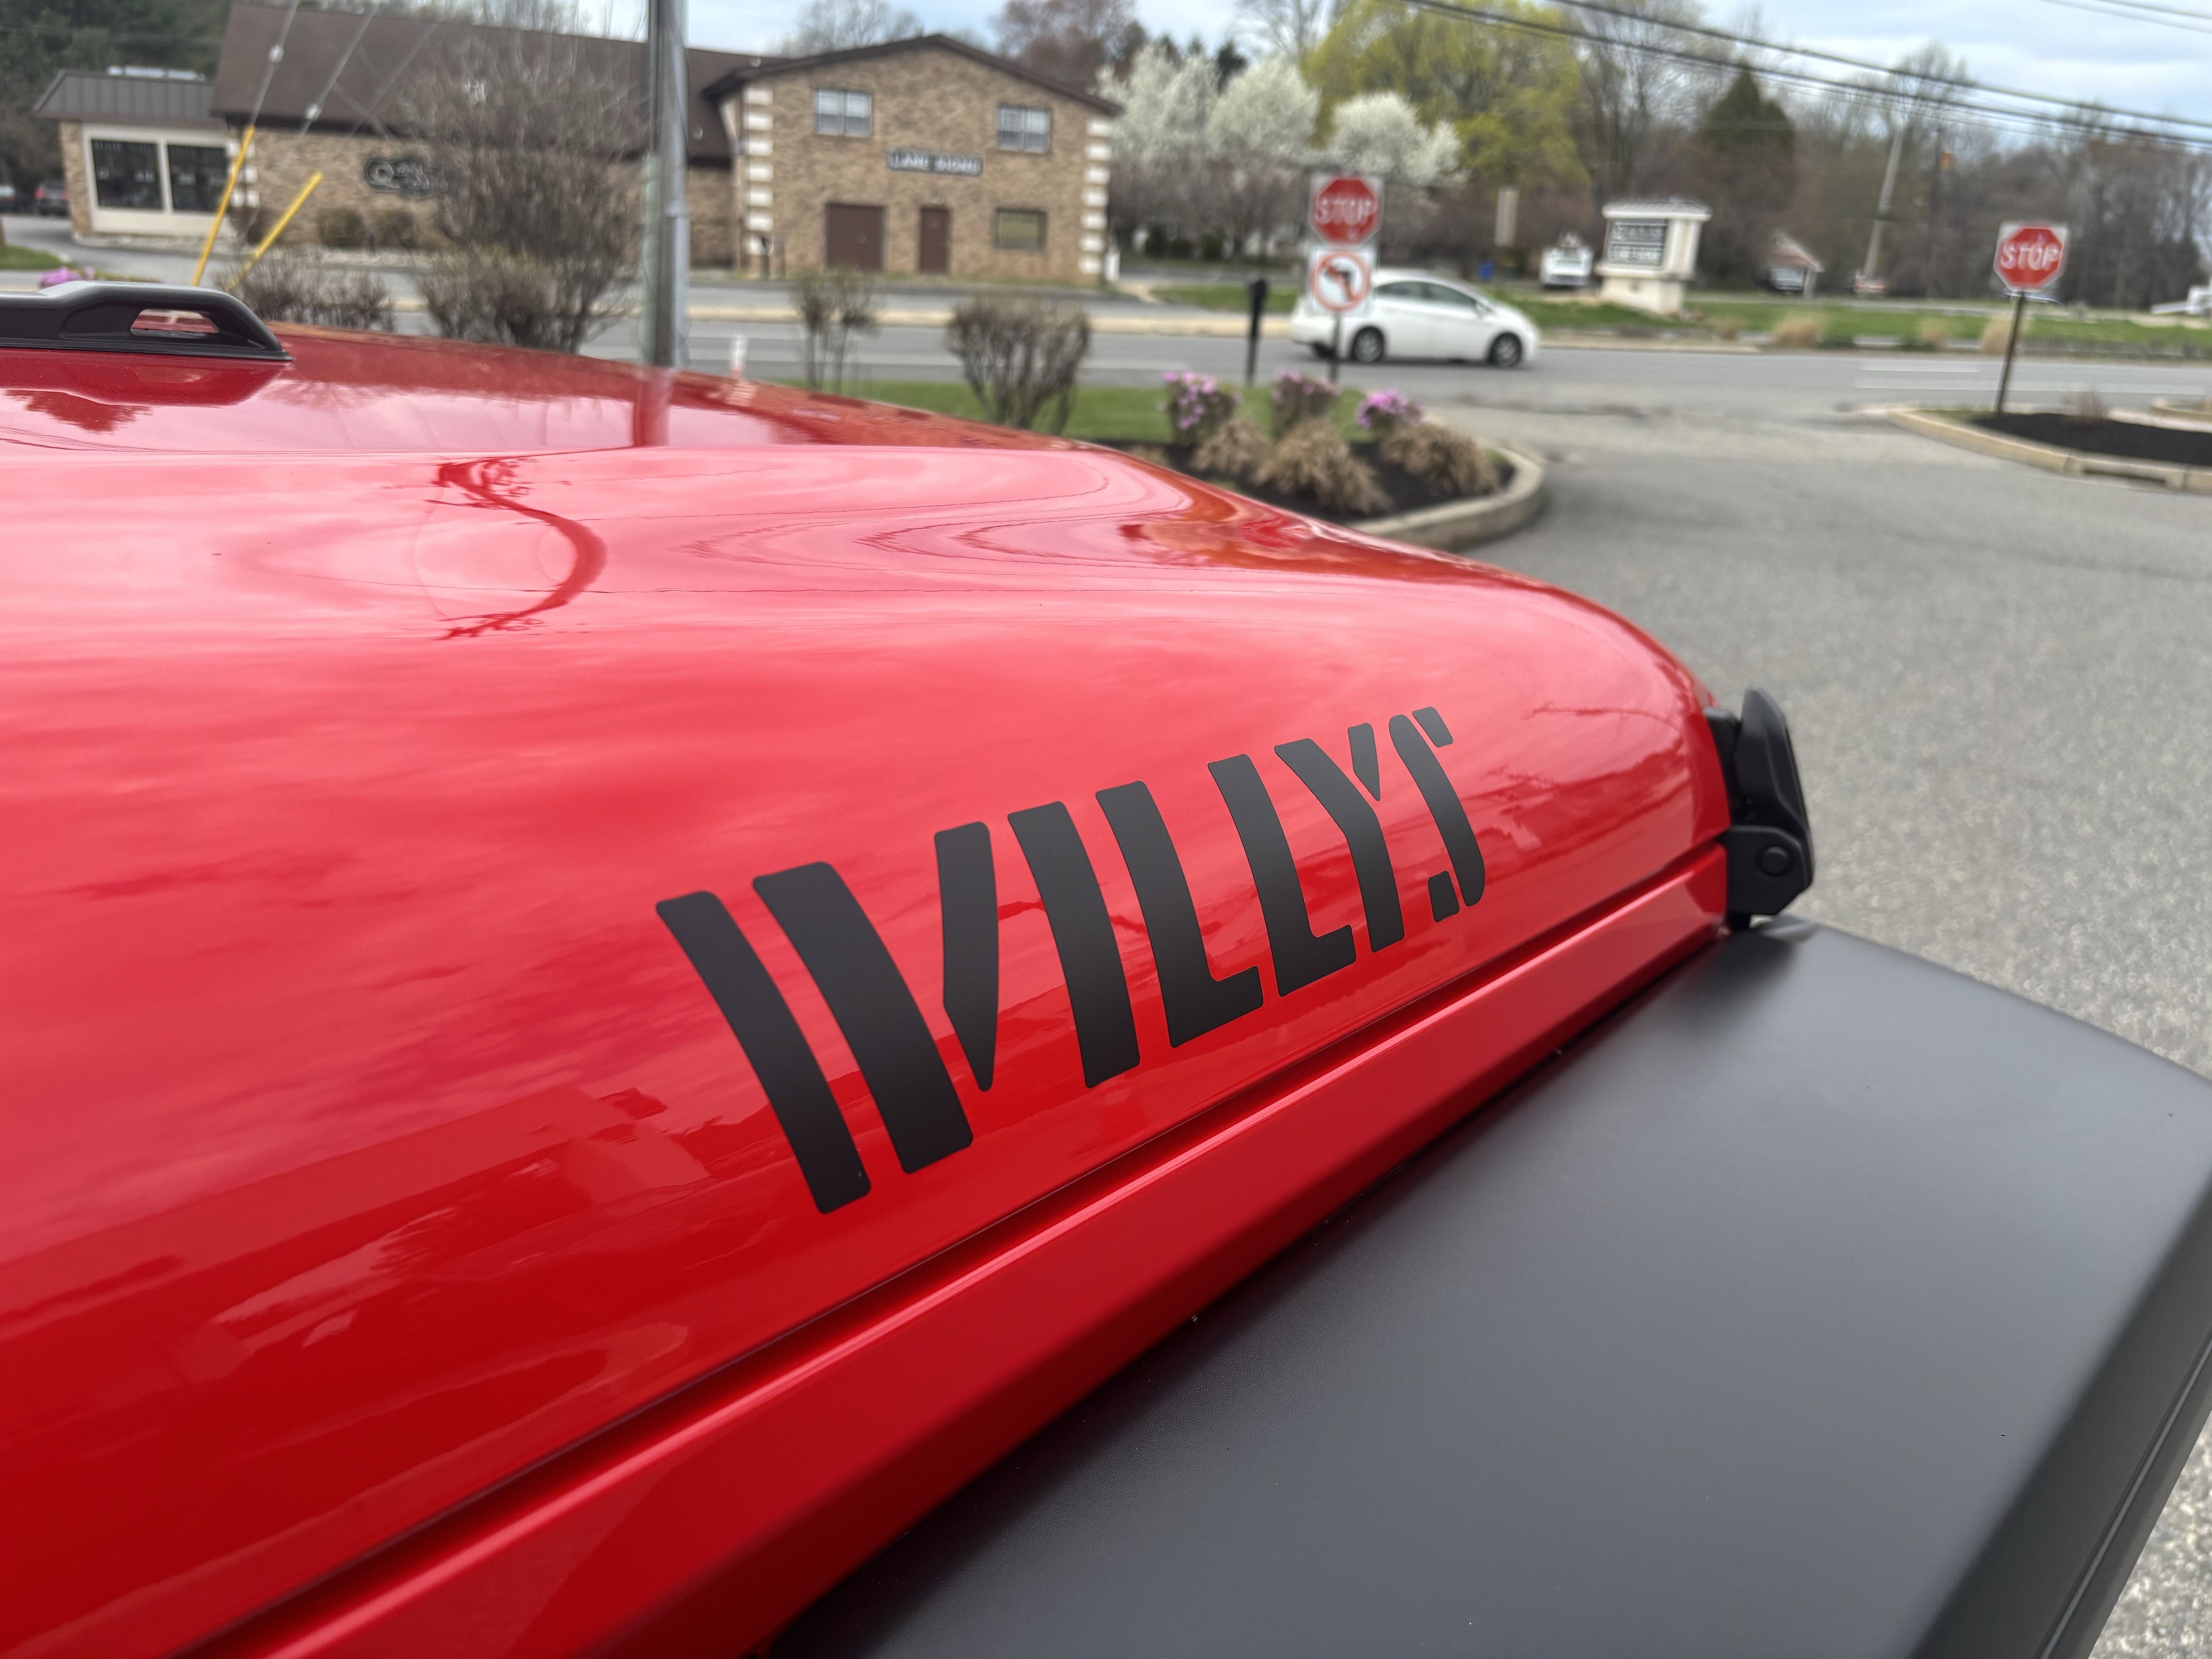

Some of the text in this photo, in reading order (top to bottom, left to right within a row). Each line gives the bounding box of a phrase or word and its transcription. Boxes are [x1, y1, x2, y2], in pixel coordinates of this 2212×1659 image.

[1316, 198, 1375, 225] STOP
[2000, 242, 2059, 270] STOP
[655, 706, 1486, 1214] WILLYS
